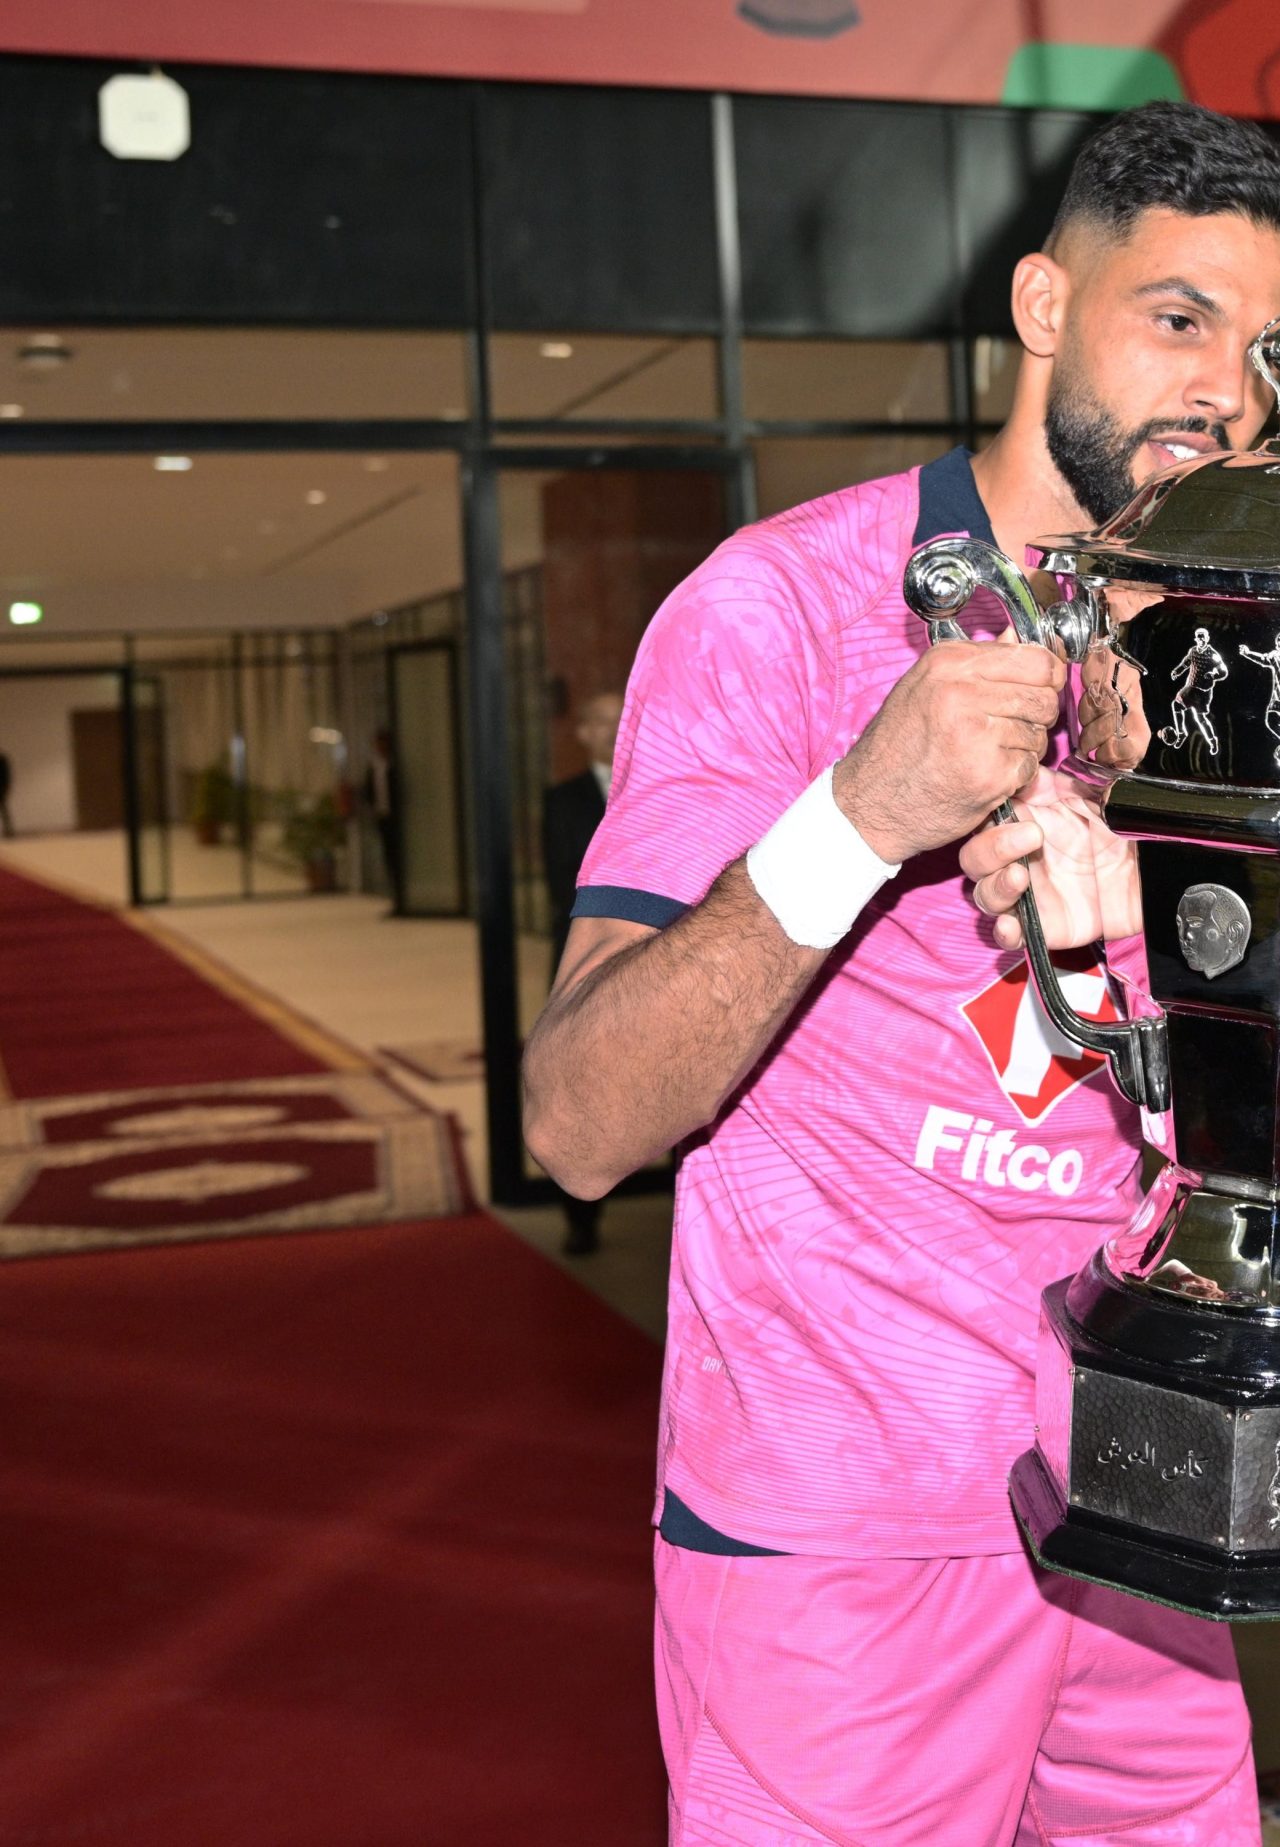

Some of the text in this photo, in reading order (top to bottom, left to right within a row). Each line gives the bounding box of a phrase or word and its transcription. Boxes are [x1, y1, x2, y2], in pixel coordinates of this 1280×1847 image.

[914, 1104, 1084, 1197] Fitco
[1097, 1437, 1209, 1481] كأس العرش
